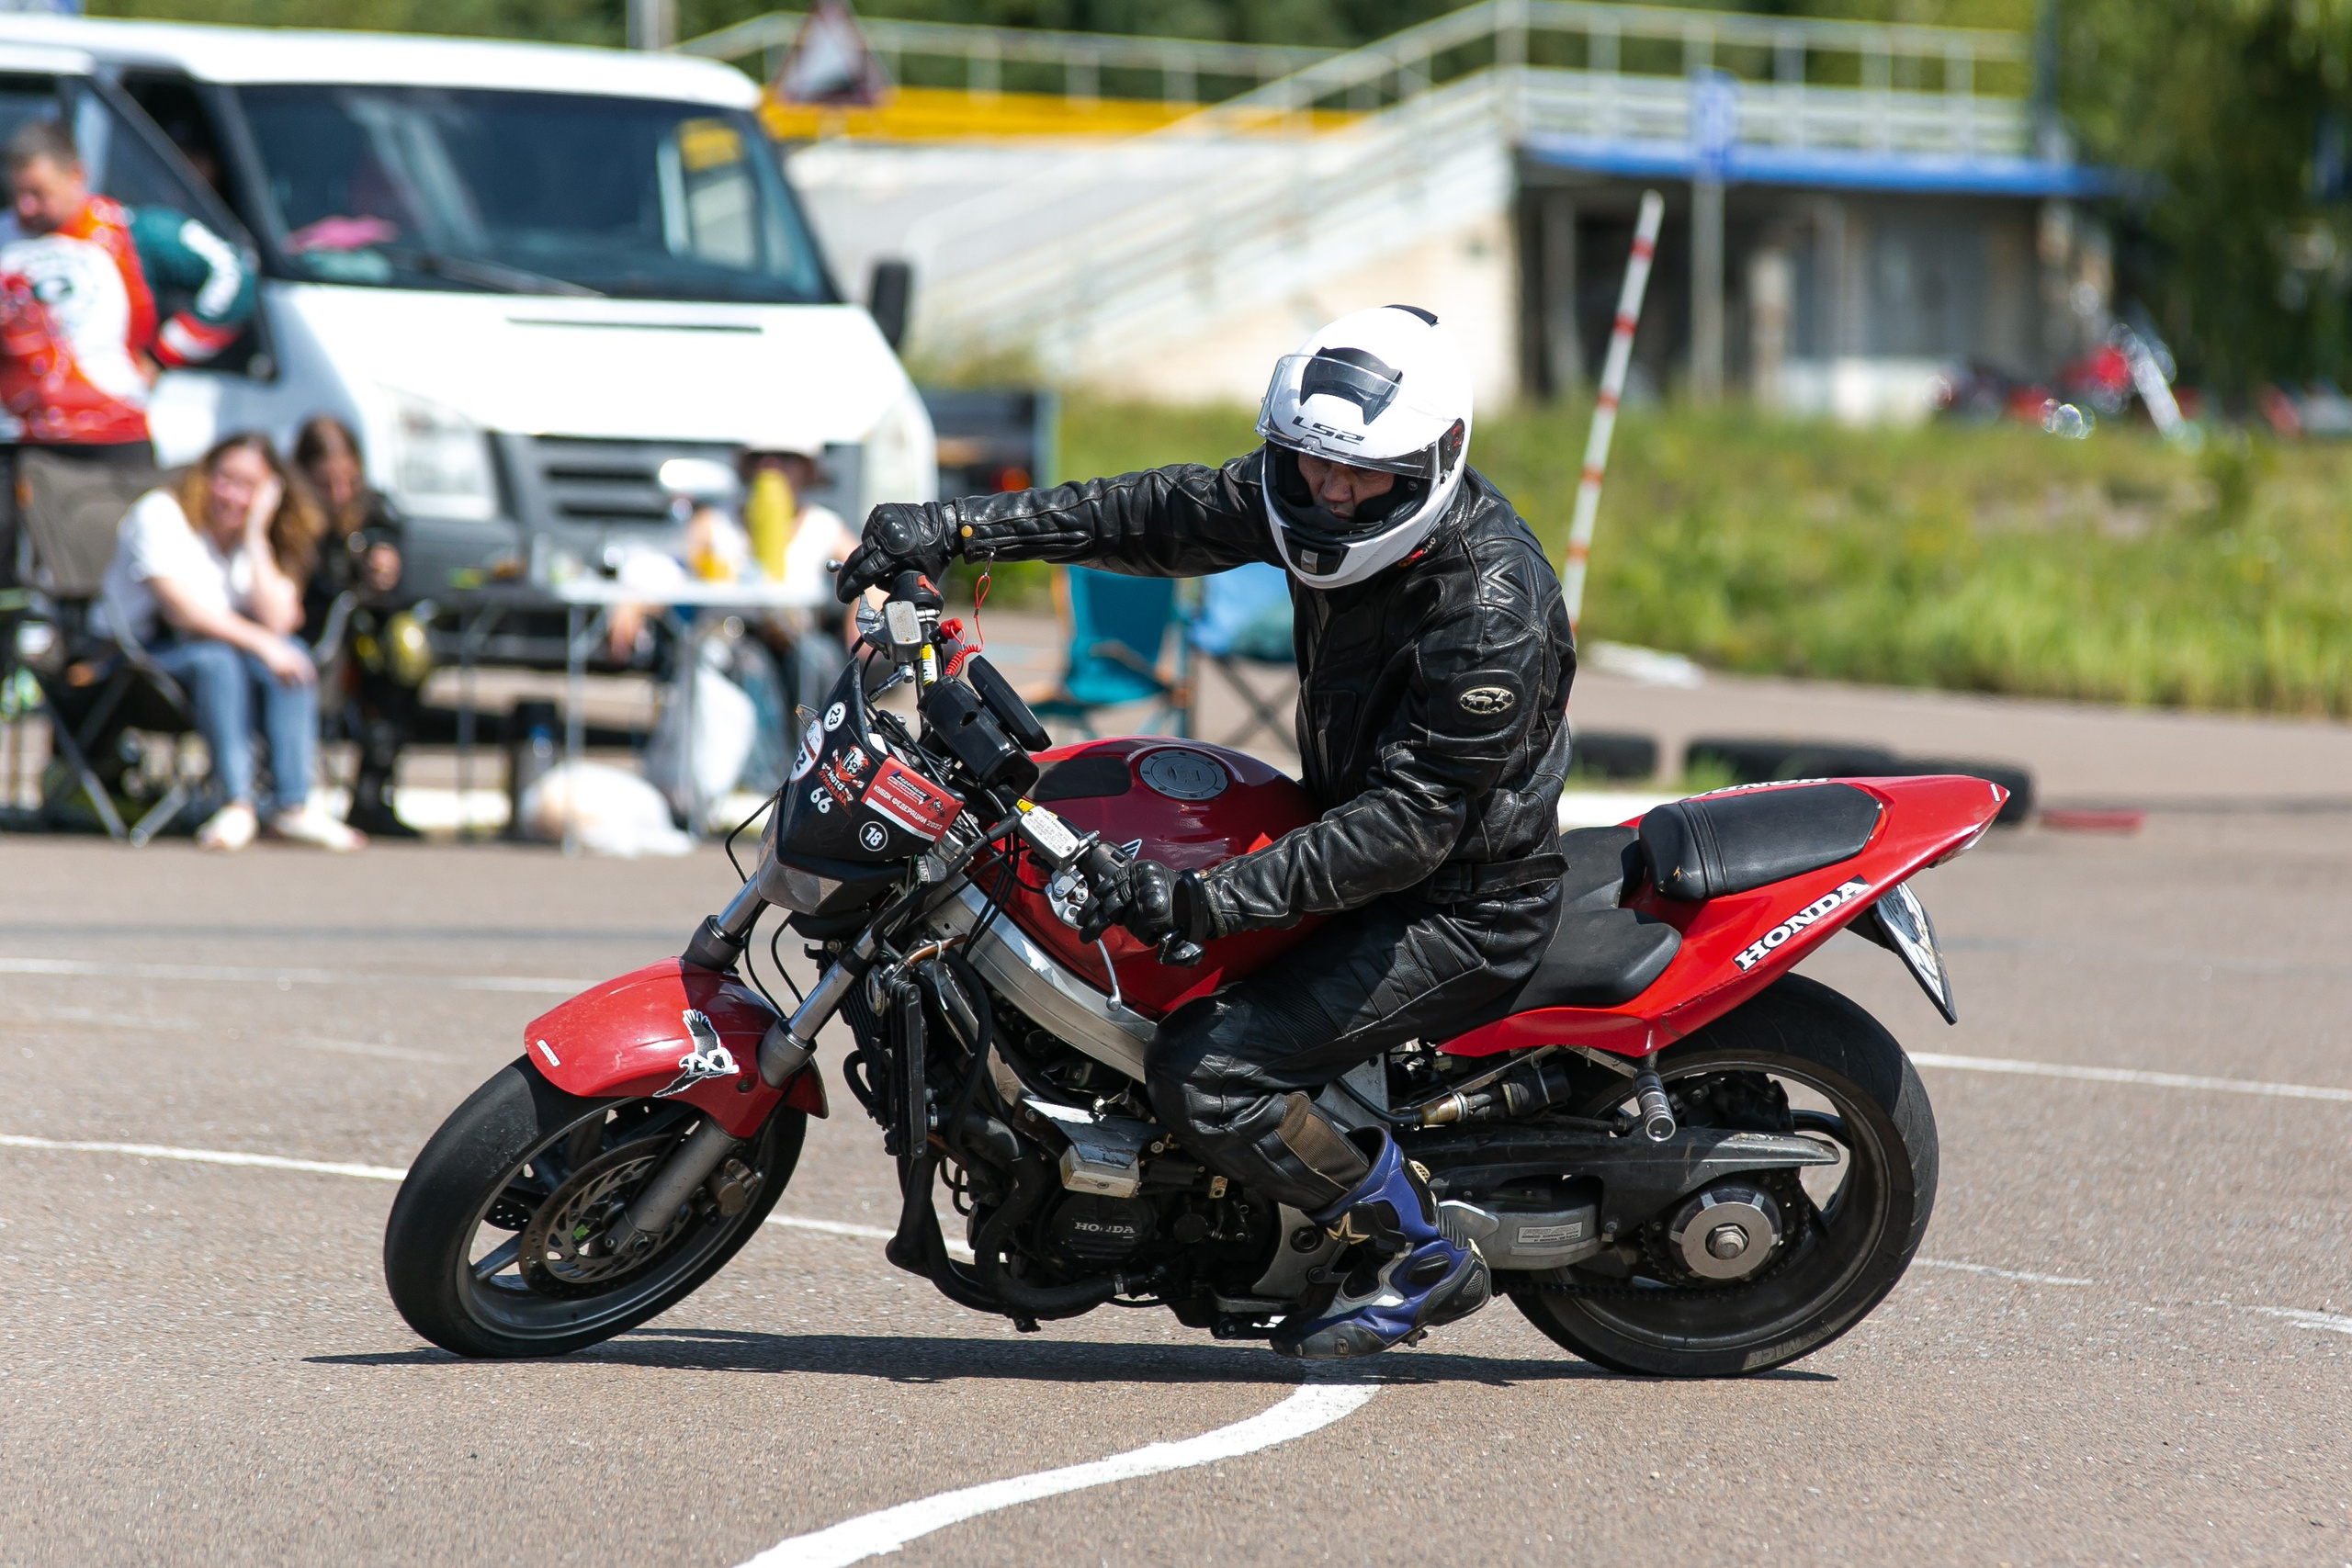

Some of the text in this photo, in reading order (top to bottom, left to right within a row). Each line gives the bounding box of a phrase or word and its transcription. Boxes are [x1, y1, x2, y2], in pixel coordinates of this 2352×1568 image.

[1292, 415, 1365, 446] LS2
[828, 708, 841, 726] 23
[827, 769, 846, 791] MOTO
[810, 786, 834, 814] 66
[873, 784, 893, 802] КУБОК
[891, 796, 927, 824] ФЕДЕРАЦИИ
[926, 819, 944, 830] 2022
[865, 827, 883, 846] 18
[1735, 881, 1871, 970] HONDA
